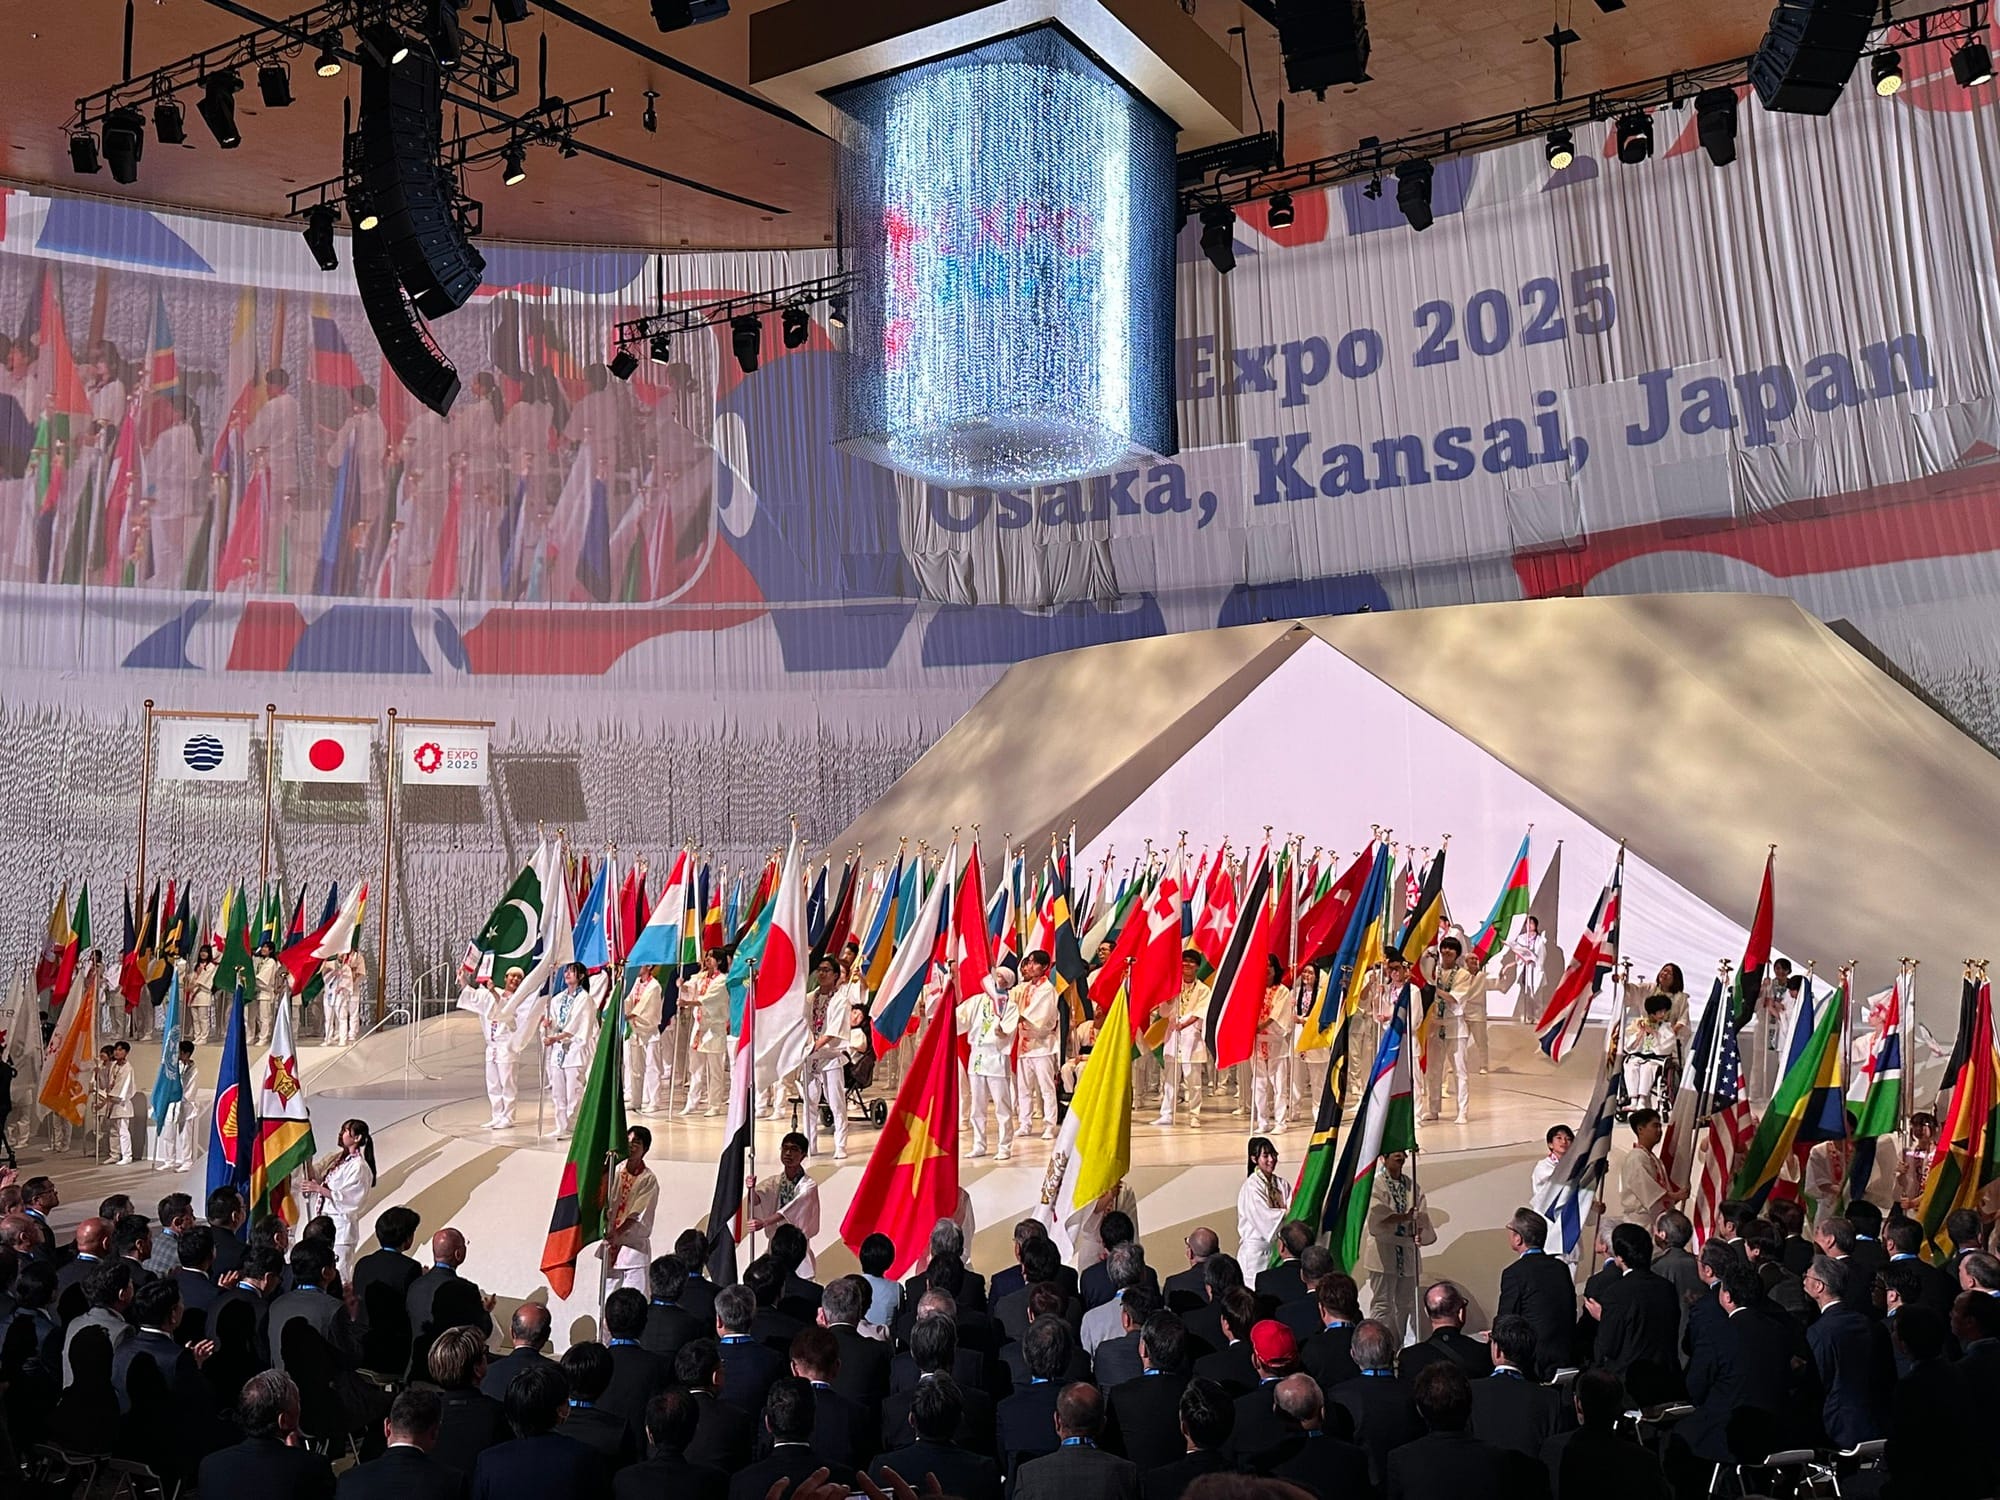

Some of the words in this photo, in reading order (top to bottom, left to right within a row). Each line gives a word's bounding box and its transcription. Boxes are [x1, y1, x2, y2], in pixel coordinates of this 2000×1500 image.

[1176, 327, 1385, 408] Expo
[1413, 266, 1617, 368] 2025
[1253, 391, 1590, 506] Kansai,
[1626, 333, 1937, 448] Japan
[447, 751, 479, 760] EXPO
[447, 760, 478, 769] 2025
